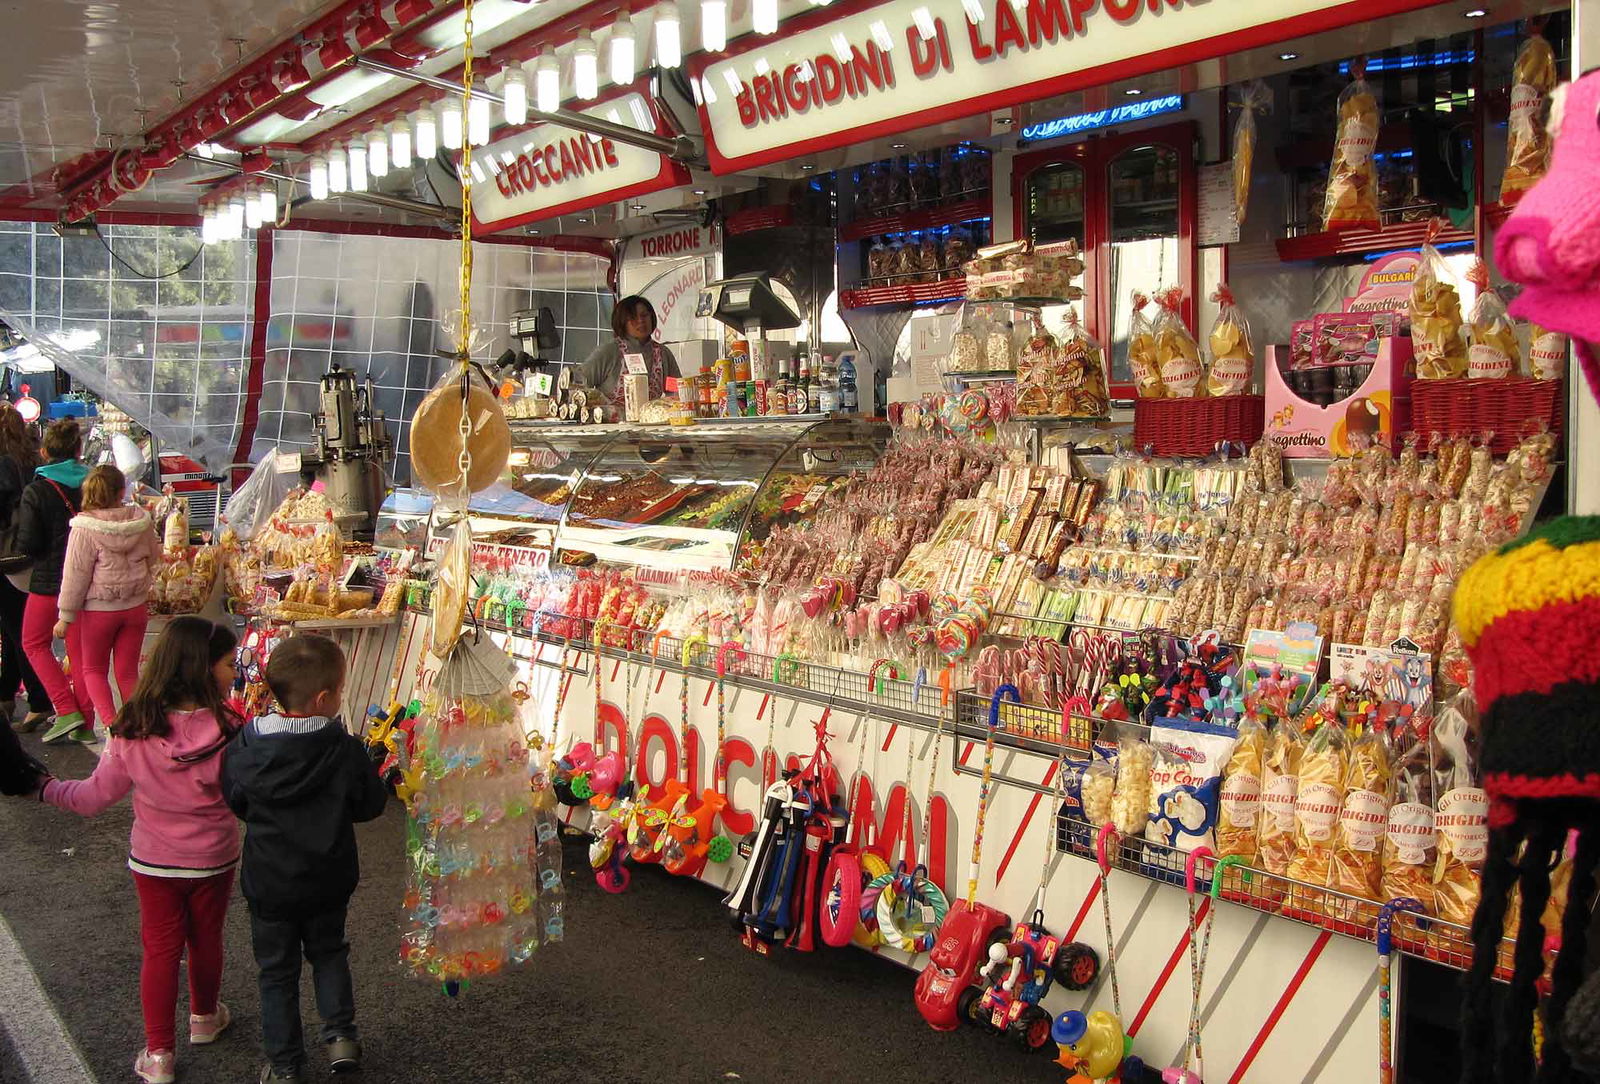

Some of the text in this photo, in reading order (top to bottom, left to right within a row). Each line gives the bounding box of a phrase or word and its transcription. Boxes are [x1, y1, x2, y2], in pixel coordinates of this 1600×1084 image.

[736, 39, 894, 127] BRIGIDINI
[906, 17, 951, 76] DI
[495, 132, 619, 198] CROCCANTE
[640, 226, 701, 258] TORRONE
[1373, 271, 1415, 284] BULGARI
[1173, 769, 1205, 785] Corn
